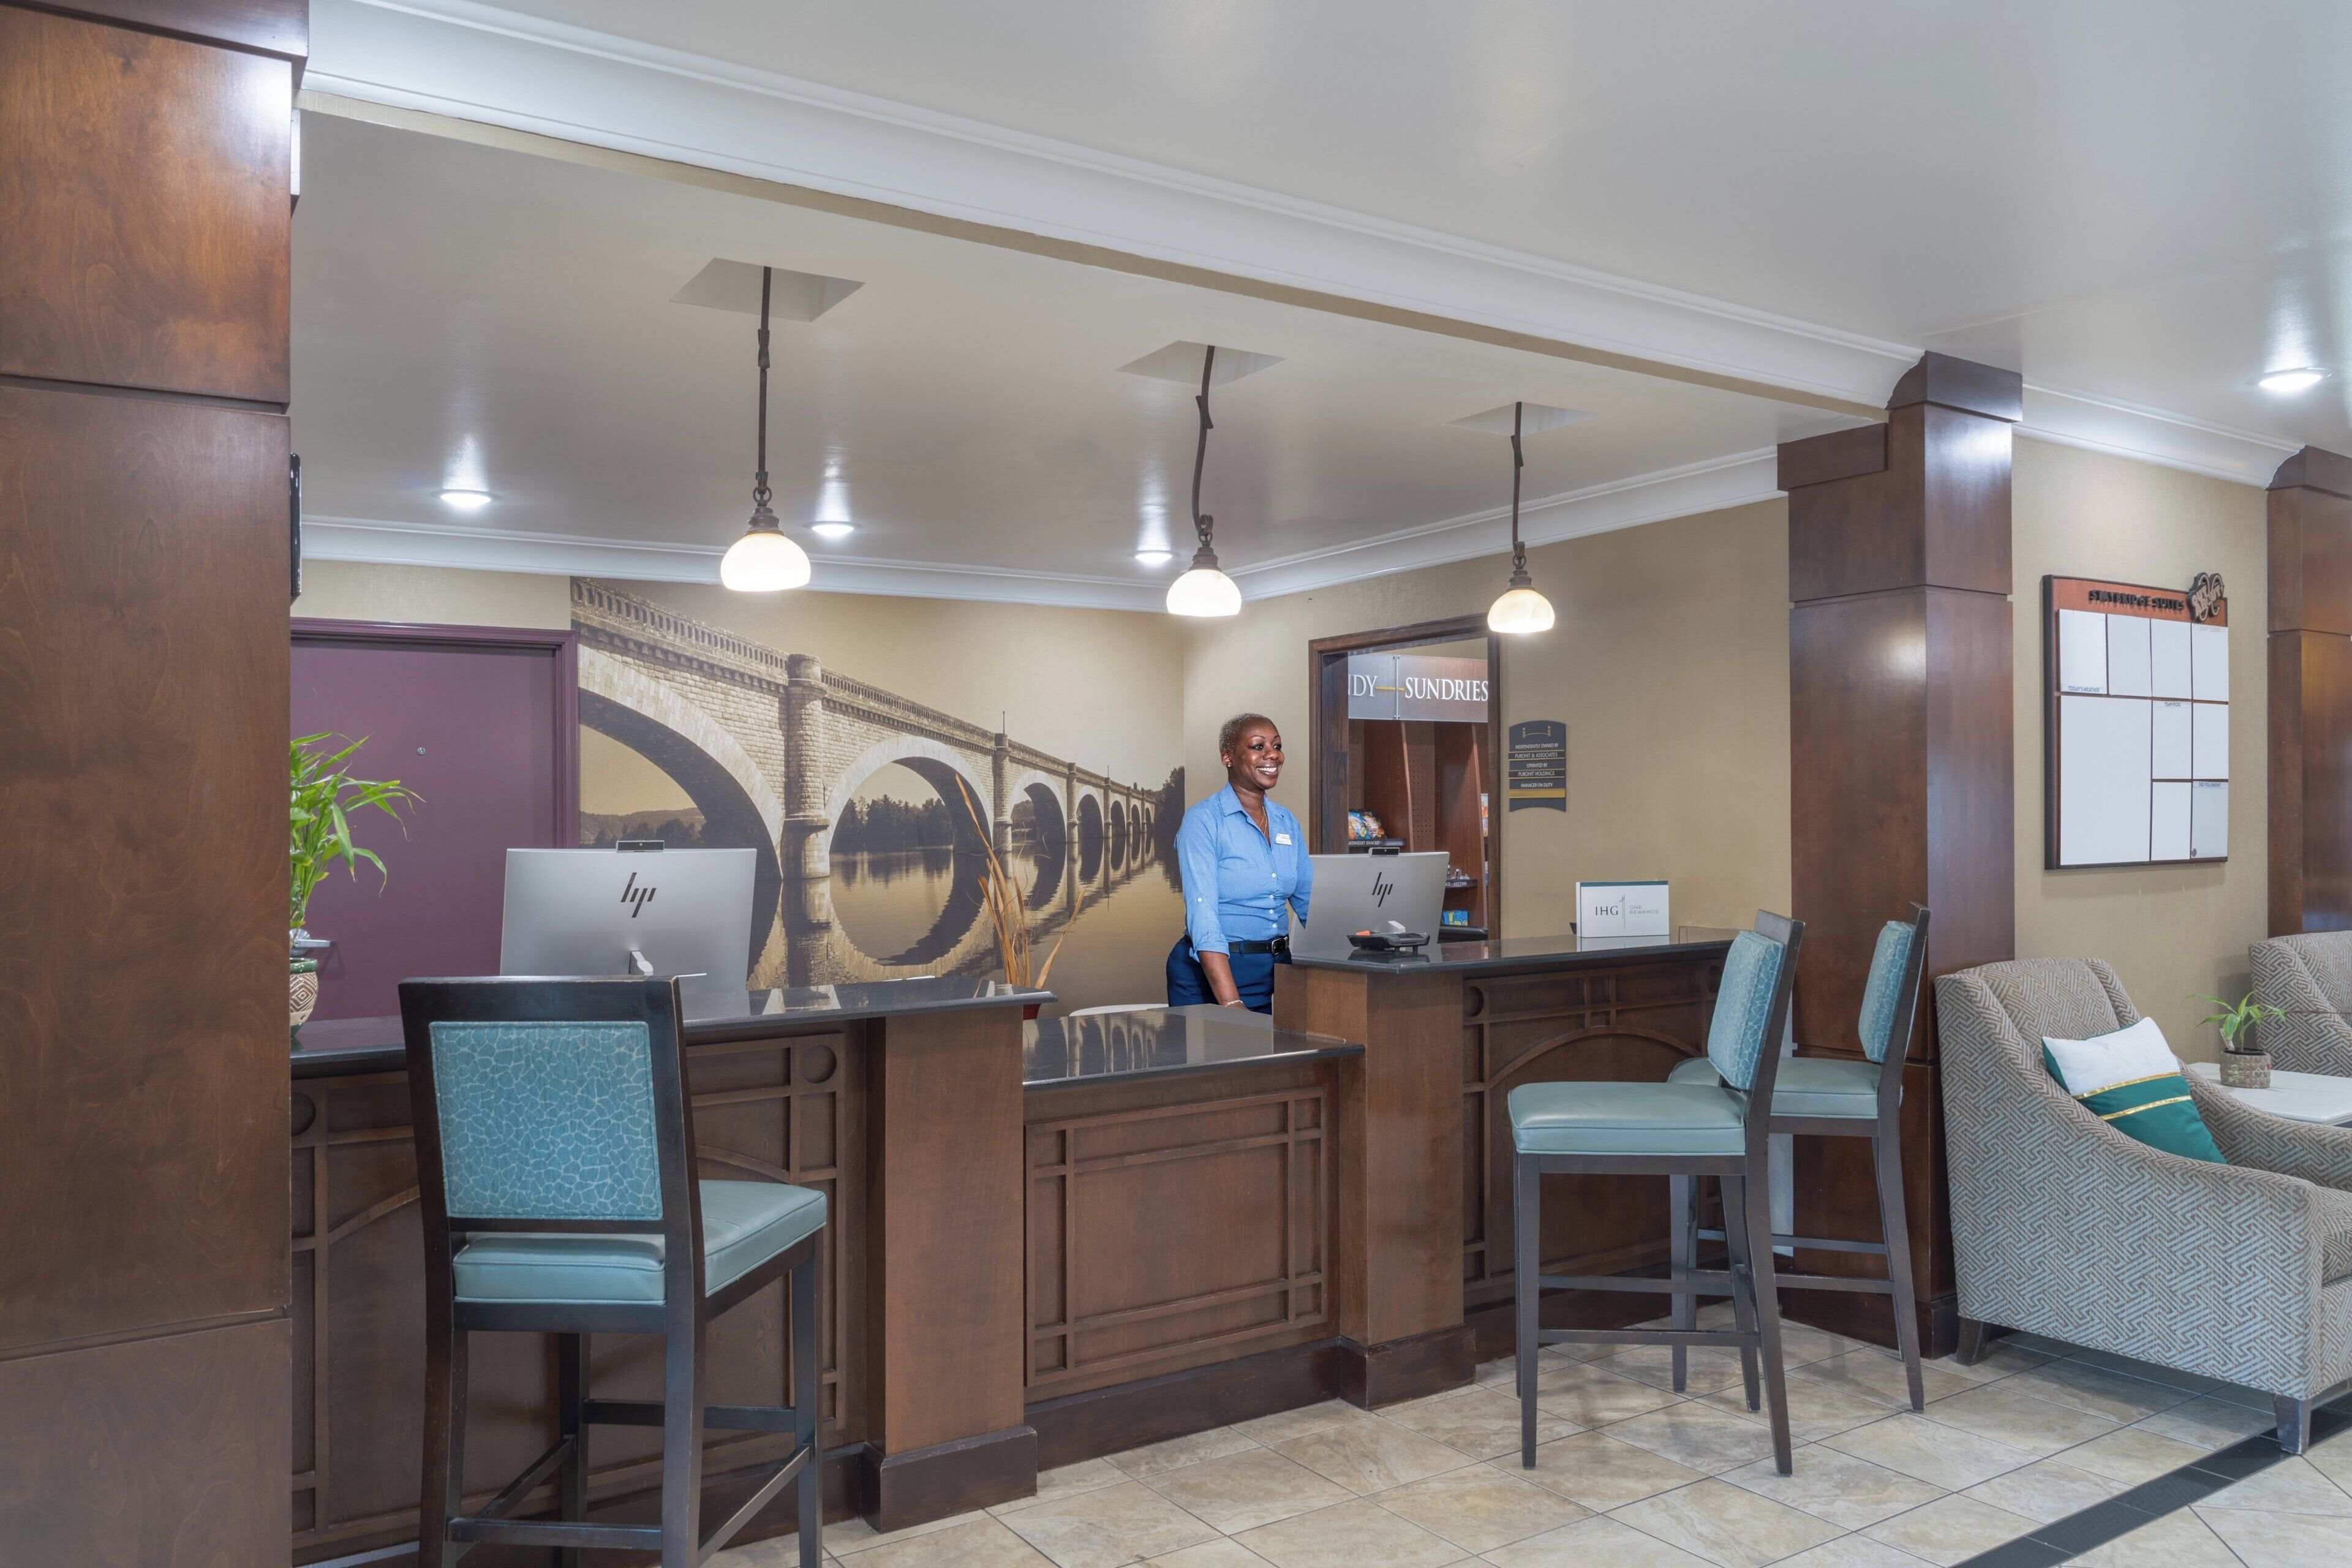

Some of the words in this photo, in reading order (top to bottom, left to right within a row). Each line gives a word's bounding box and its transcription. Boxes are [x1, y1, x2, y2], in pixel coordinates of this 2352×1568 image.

[2152, 597, 2184, 611] SUITES
[1405, 676, 1488, 702] SUNDRIES
[620, 872, 657, 918] hp
[1371, 872, 1393, 908] hp
[1595, 905, 1619, 916] IHG
